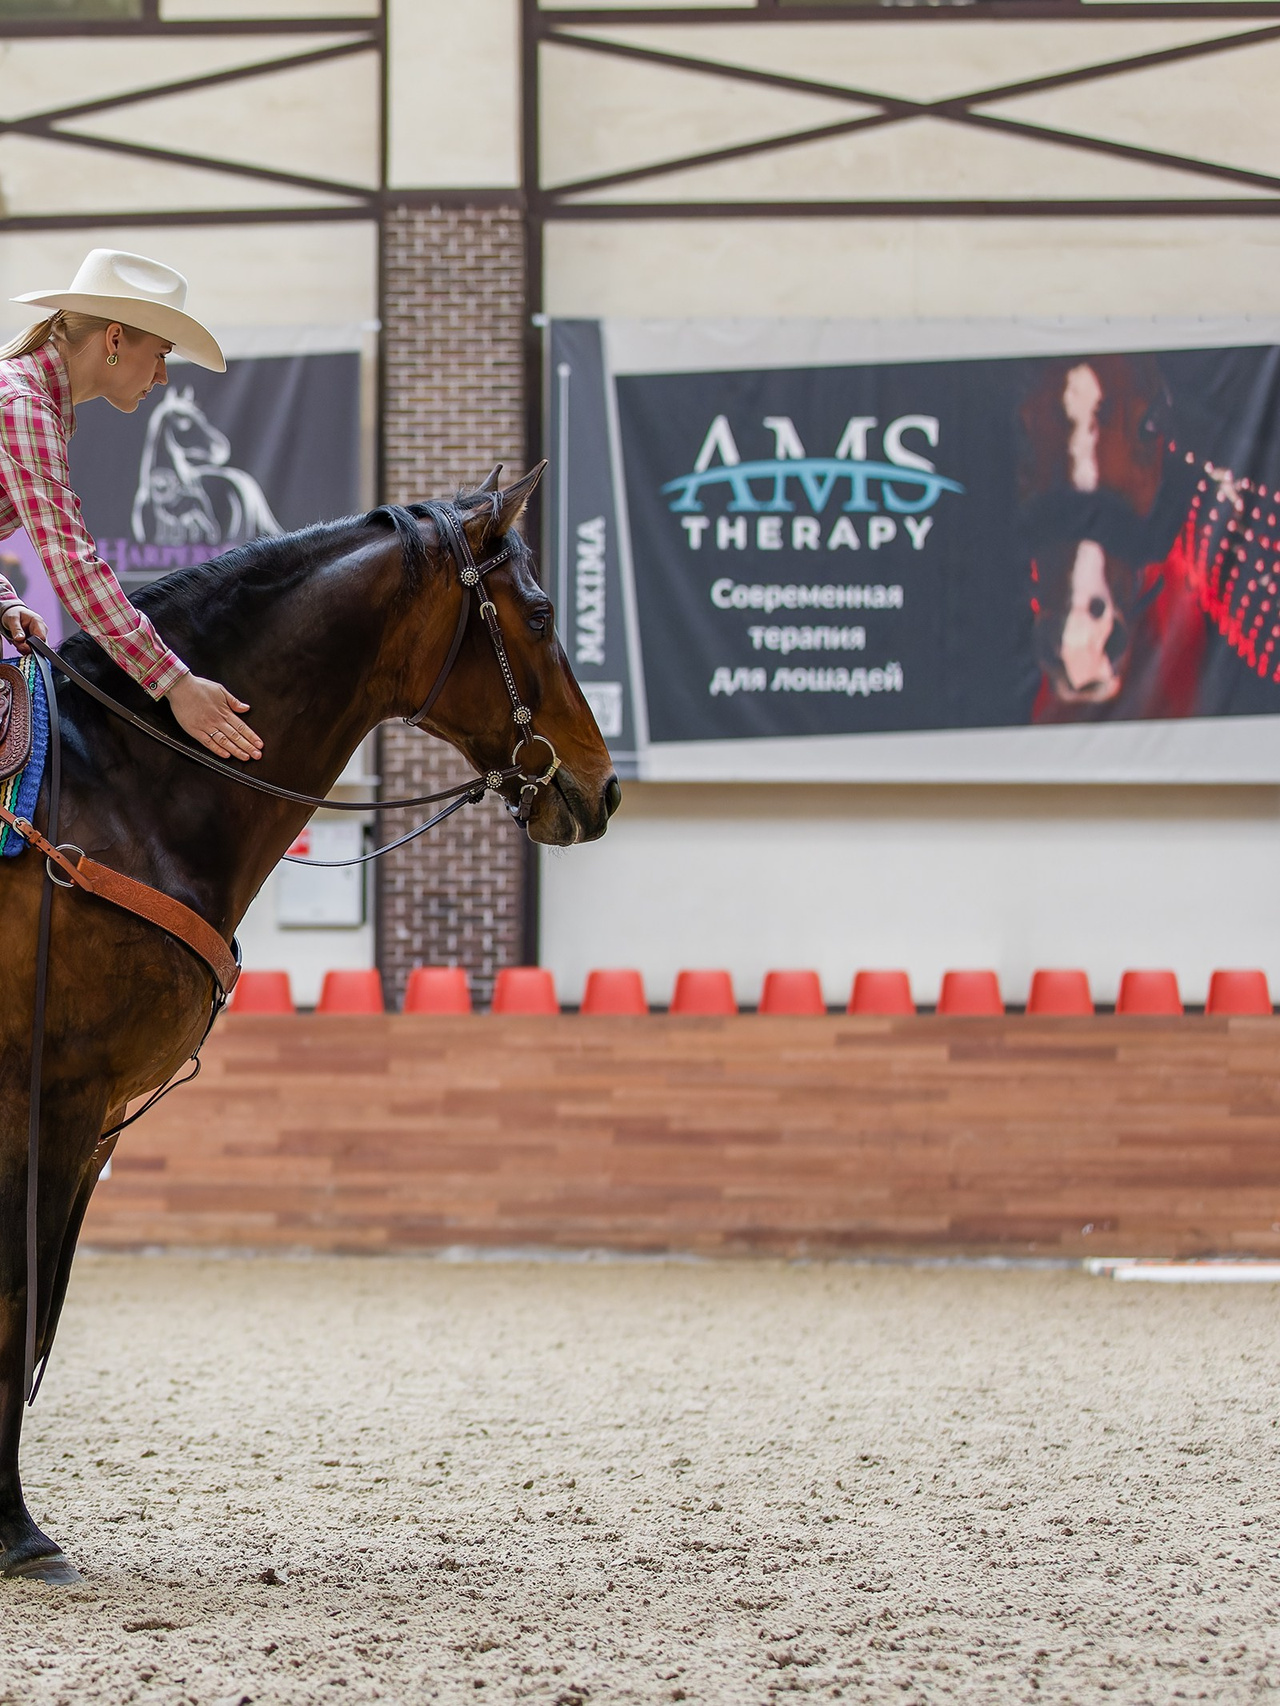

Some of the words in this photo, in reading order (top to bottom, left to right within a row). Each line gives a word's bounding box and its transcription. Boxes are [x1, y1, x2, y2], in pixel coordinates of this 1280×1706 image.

[669, 415, 941, 512] AMS
[681, 516, 933, 550] THERAPY
[577, 516, 606, 665] MAXIMA
[710, 579, 904, 612] Современная
[748, 625, 865, 654] терапия
[709, 666, 766, 696] для
[771, 662, 904, 696] лошадей
